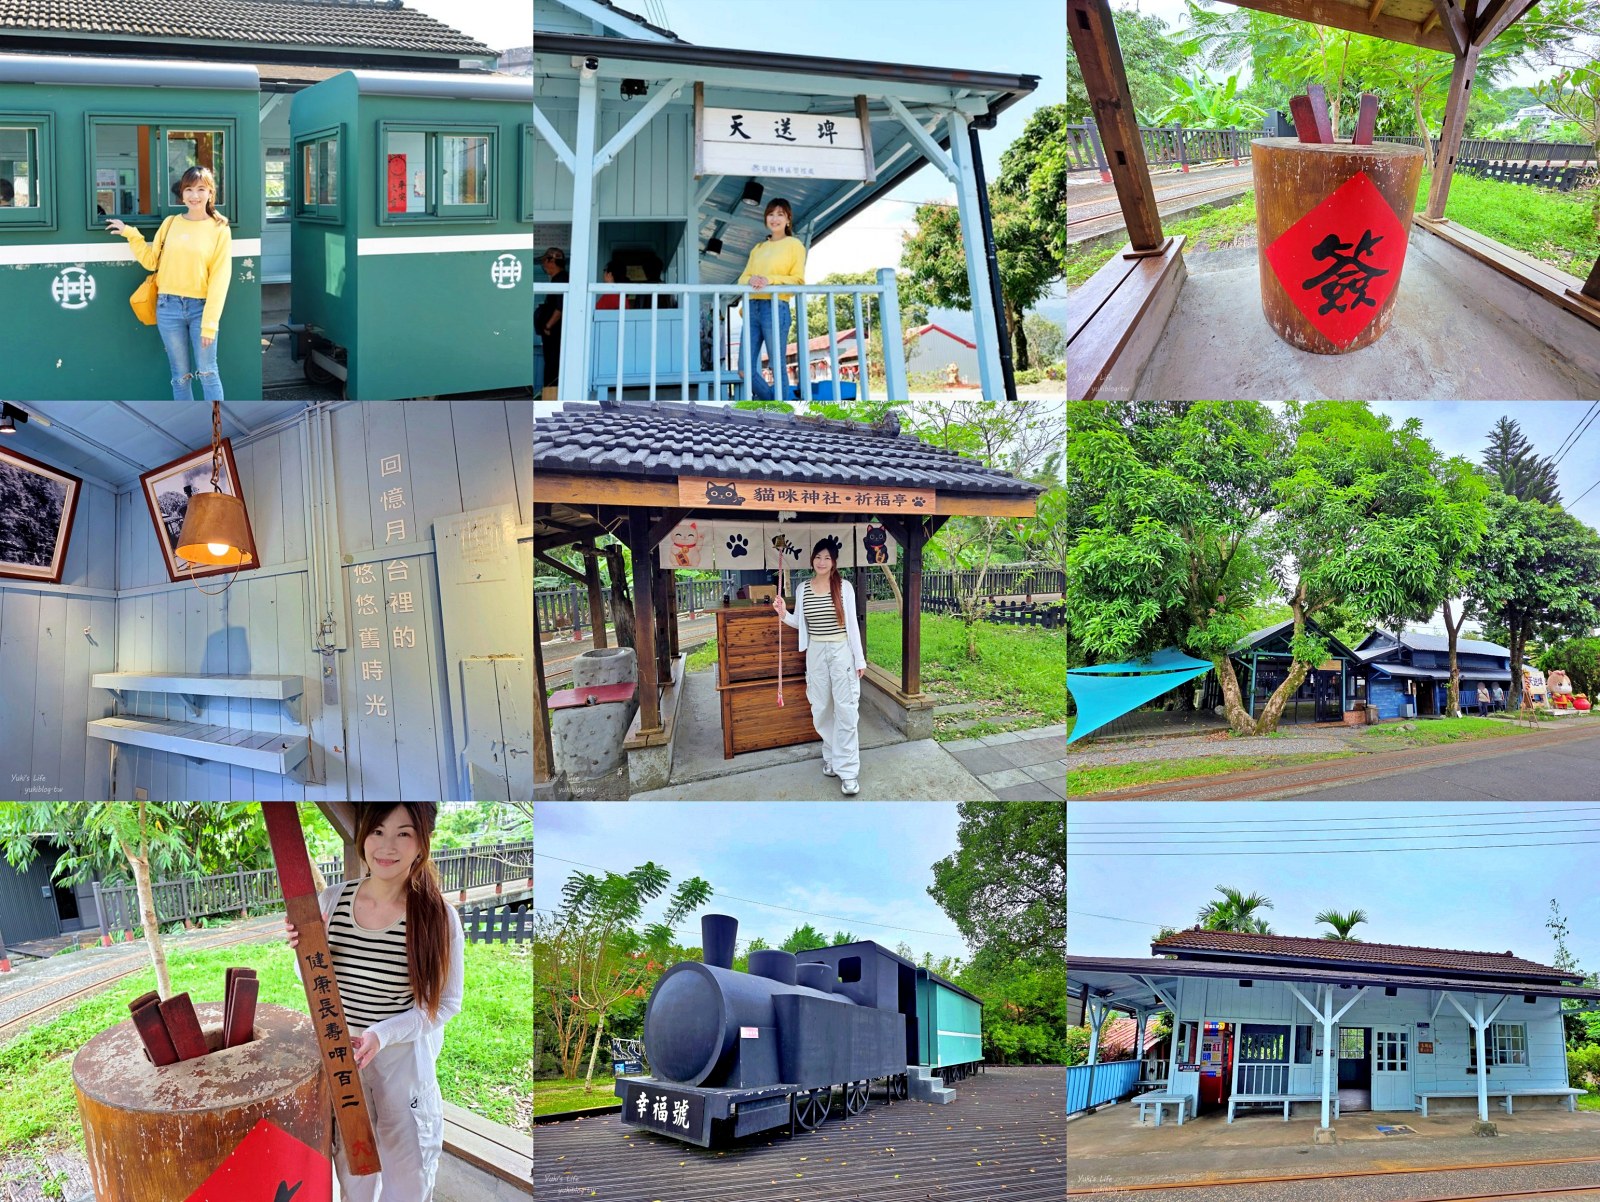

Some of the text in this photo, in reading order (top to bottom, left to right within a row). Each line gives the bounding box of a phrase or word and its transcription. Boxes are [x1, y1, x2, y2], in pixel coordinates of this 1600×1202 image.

[729, 114, 838, 144] 天送埤
[380, 453, 416, 648] 回憶月台裡的
[354, 563, 388, 717] 悠悠舊時光
[305, 951, 360, 1109] 健康長壽呷百二
[636, 1091, 690, 1129] 幸福號
